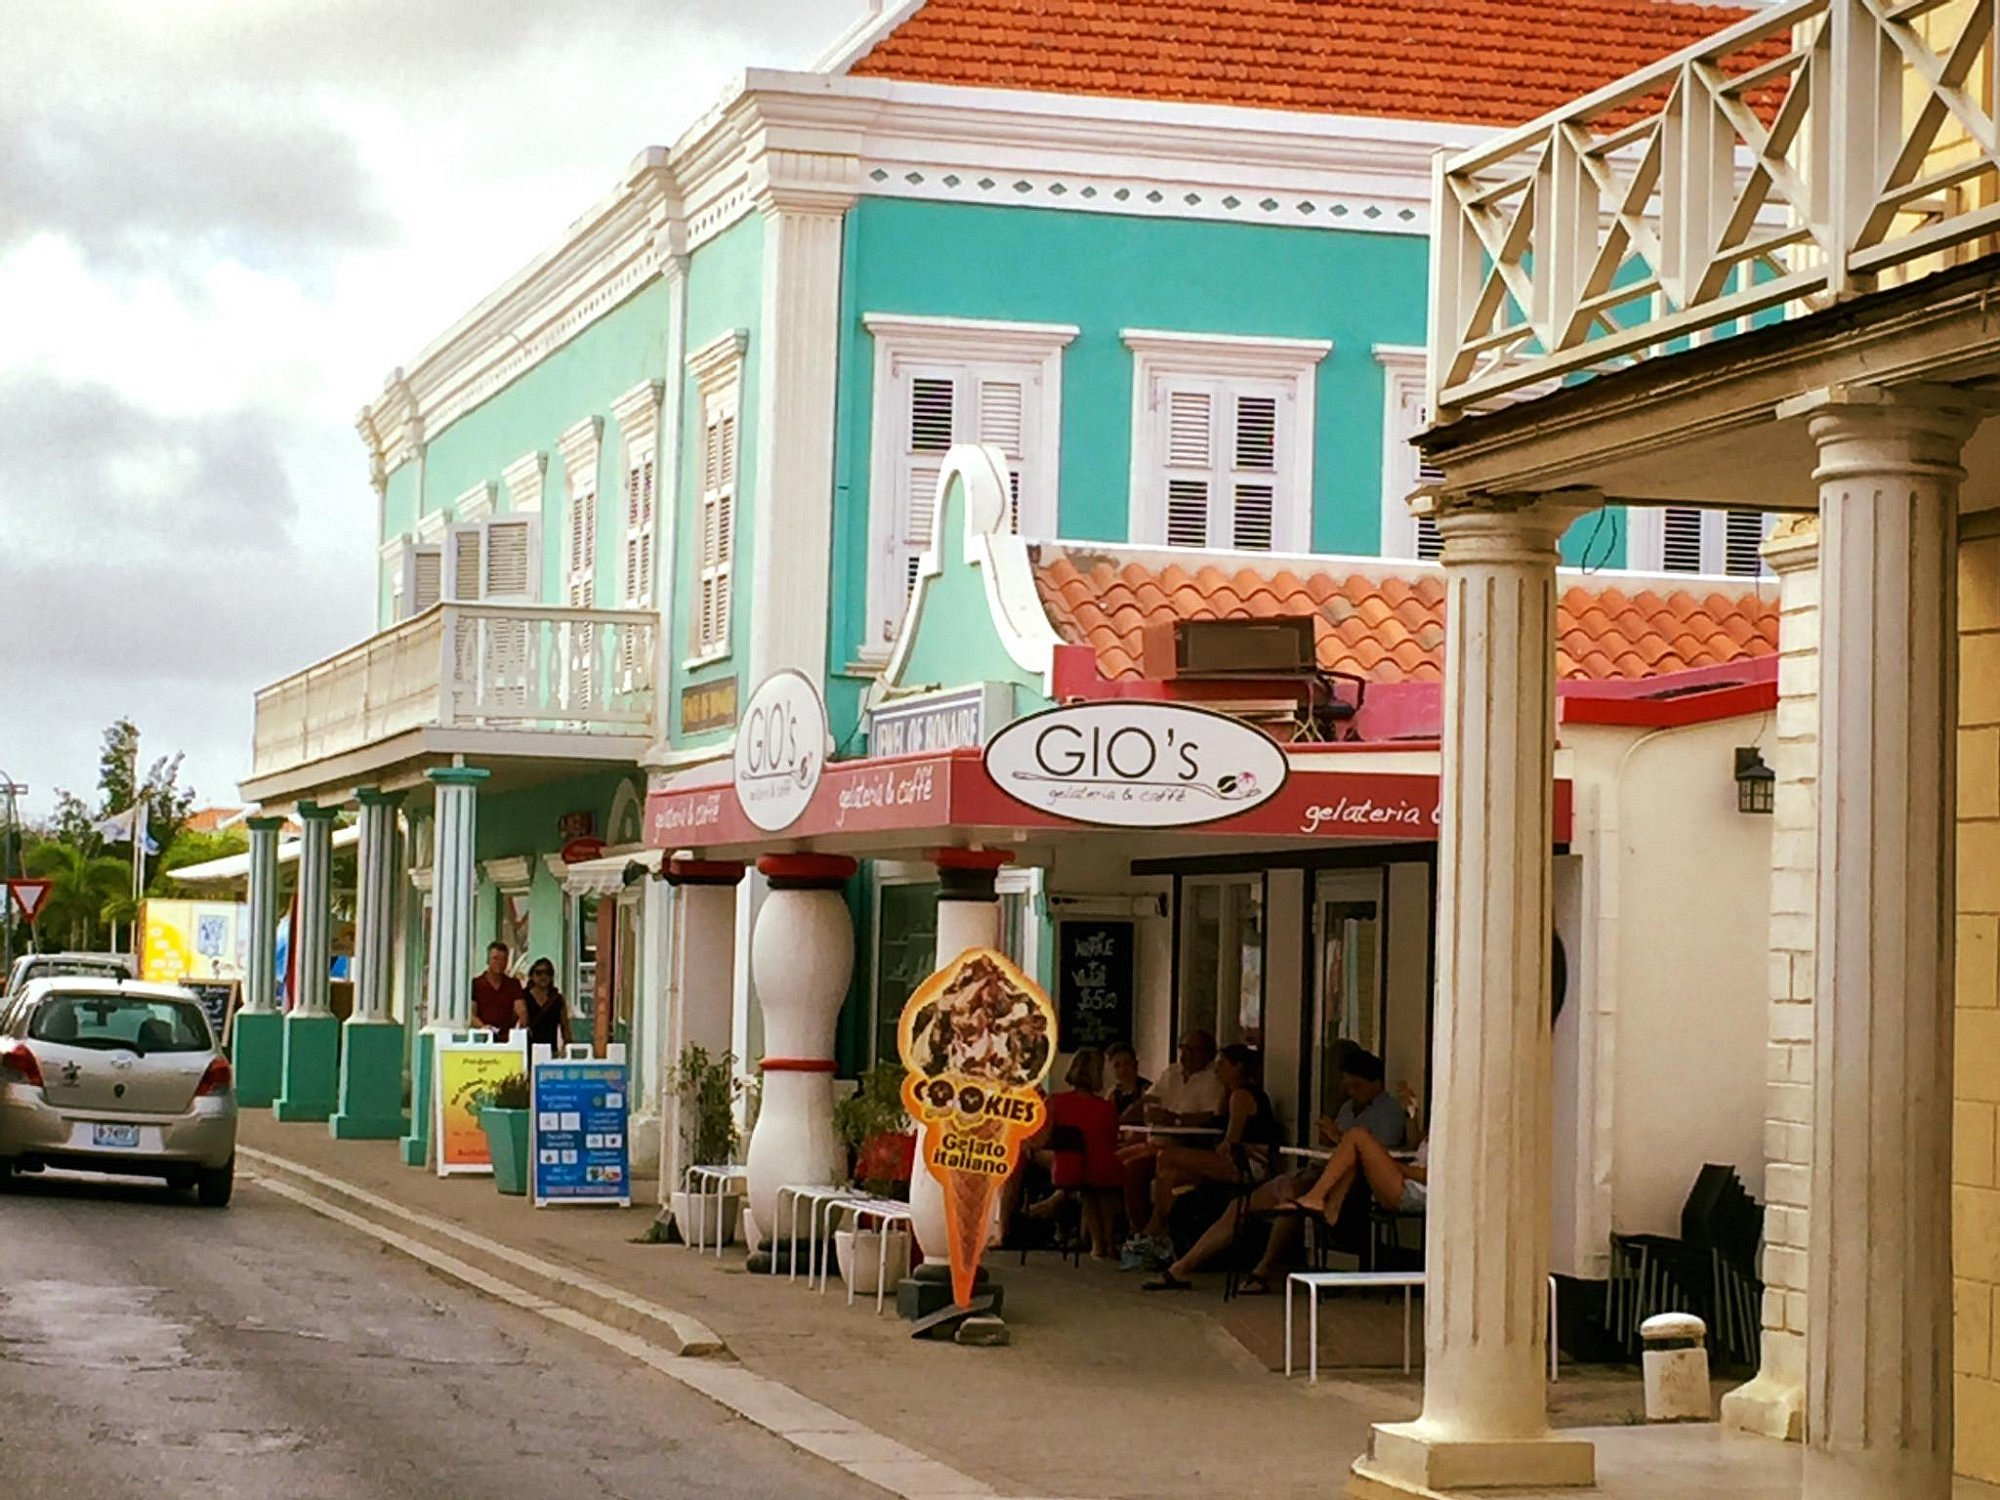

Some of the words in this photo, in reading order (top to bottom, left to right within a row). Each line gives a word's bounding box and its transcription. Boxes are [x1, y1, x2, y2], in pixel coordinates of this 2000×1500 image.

[747, 700, 796, 773] GIO's
[1036, 725, 1198, 780] GIO's
[1299, 797, 1421, 833] gelateria
[914, 1079, 1035, 1123] COOKIES
[942, 1132, 1007, 1158] Gelato
